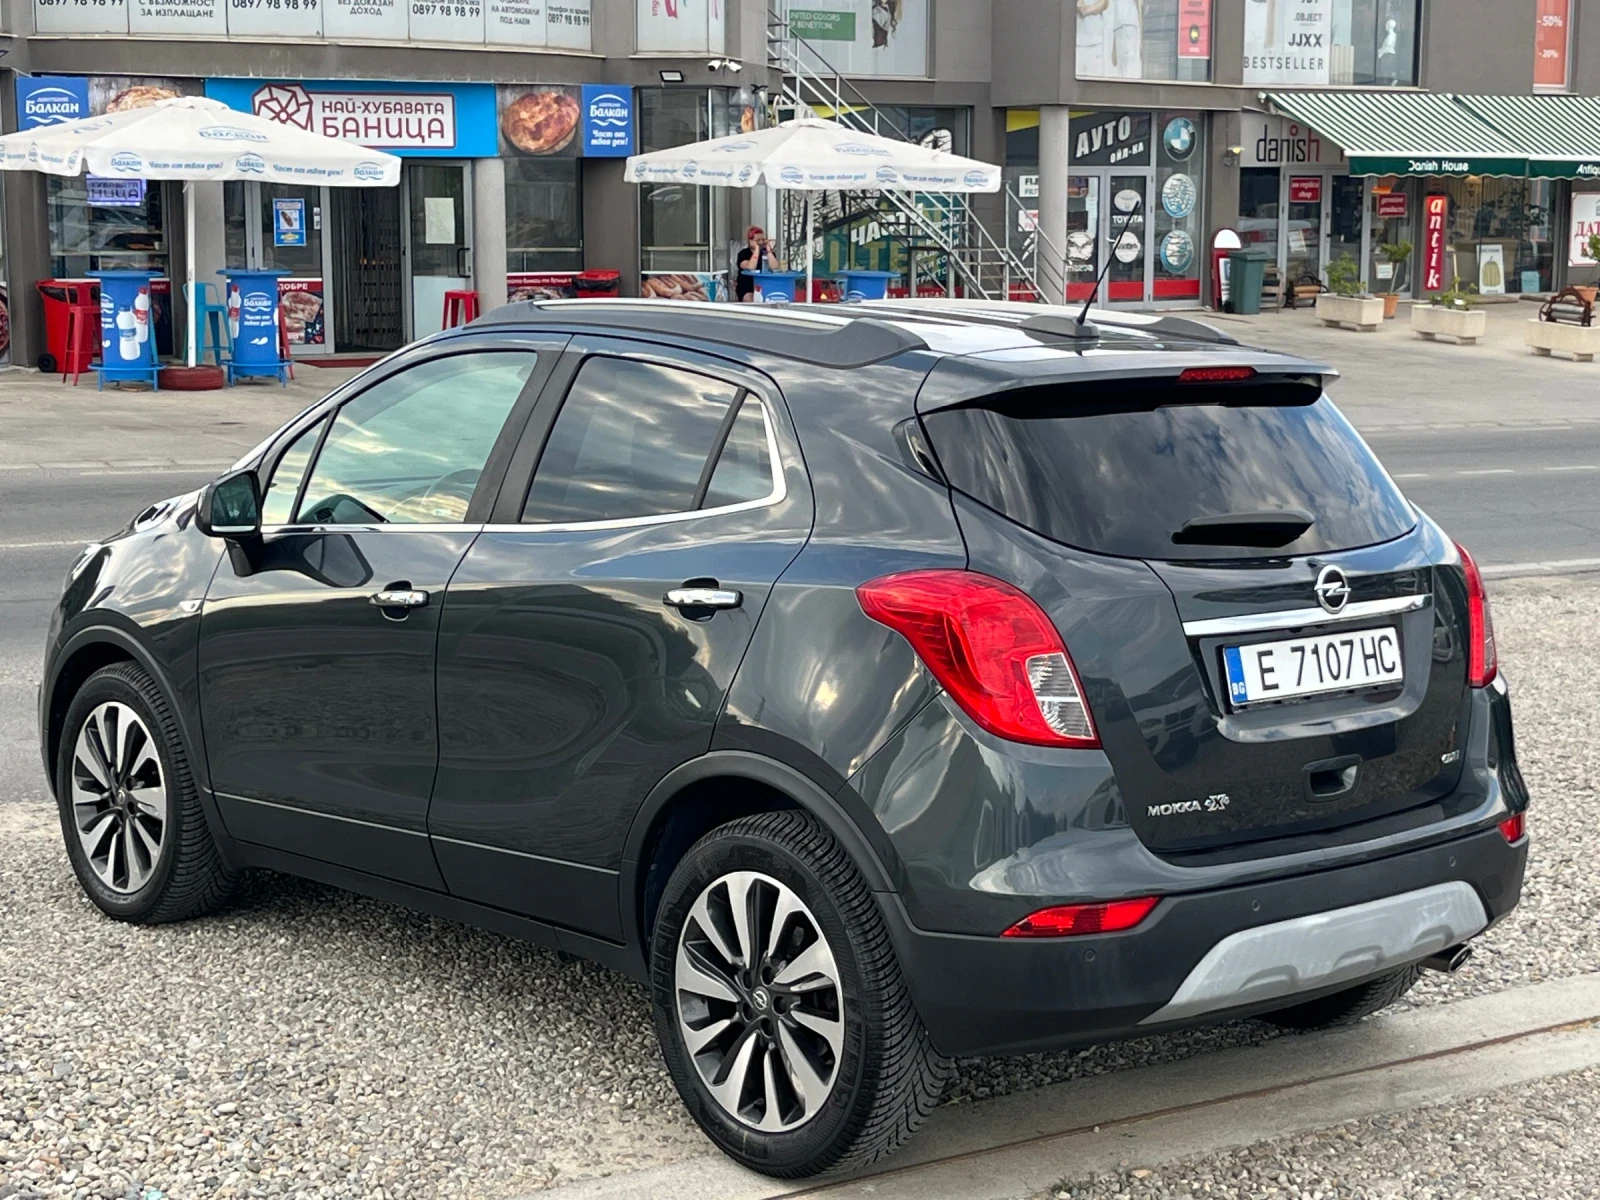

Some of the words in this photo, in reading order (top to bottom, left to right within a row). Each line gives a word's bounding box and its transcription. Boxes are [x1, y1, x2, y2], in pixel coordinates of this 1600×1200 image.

[232, 0, 261, 9] 0897
[266, 0, 280, 9] 98
[285, 0, 299, 10] 98
[303, 0, 317, 10] 99
[350, 7, 383, 16] ДОХОД
[412, 4, 437, 15] 0897
[440, 5, 452, 16] 98
[455, 6, 466, 17] 98
[469, 7, 480, 18] 99
[141, 8, 153, 16] ЗА
[155, 9, 214, 18] ИЗПЛАЩАНЕ
[548, 13, 563, 23] 0897
[564, 14, 573, 25] 98
[574, 15, 582, 26] 98
[582, 16, 590, 26] 99
[1288, 33, 1323, 48] JJXX
[1243, 56, 1324, 70] BESTSELLER
[25, 99, 80, 114] Балкан
[322, 97, 445, 114] НАЙ-ХУБАВАТА
[590, 104, 629, 118] Балкан
[322, 117, 445, 144] БАНИЦА
[1076, 115, 1131, 159] АУТО
[1256, 124, 1320, 162] danish
[1110, 141, 1144, 163] ОЙЛ-КА
[111, 158, 142, 167] Балкан
[235, 159, 265, 169] Балкан
[1408, 160, 1438, 172] Danish
[1441, 161, 1469, 172] House
[353, 167, 384, 176] Балкан
[1112, 215, 1143, 224] TOYOTA
[1427, 199, 1443, 288] antik
[1231, 681, 1246, 696] BG
[1257, 649, 1280, 692] E
[1290, 638, 1354, 687] 7107
[1360, 634, 1396, 677] HC
[1147, 800, 1202, 817] MOKKA
